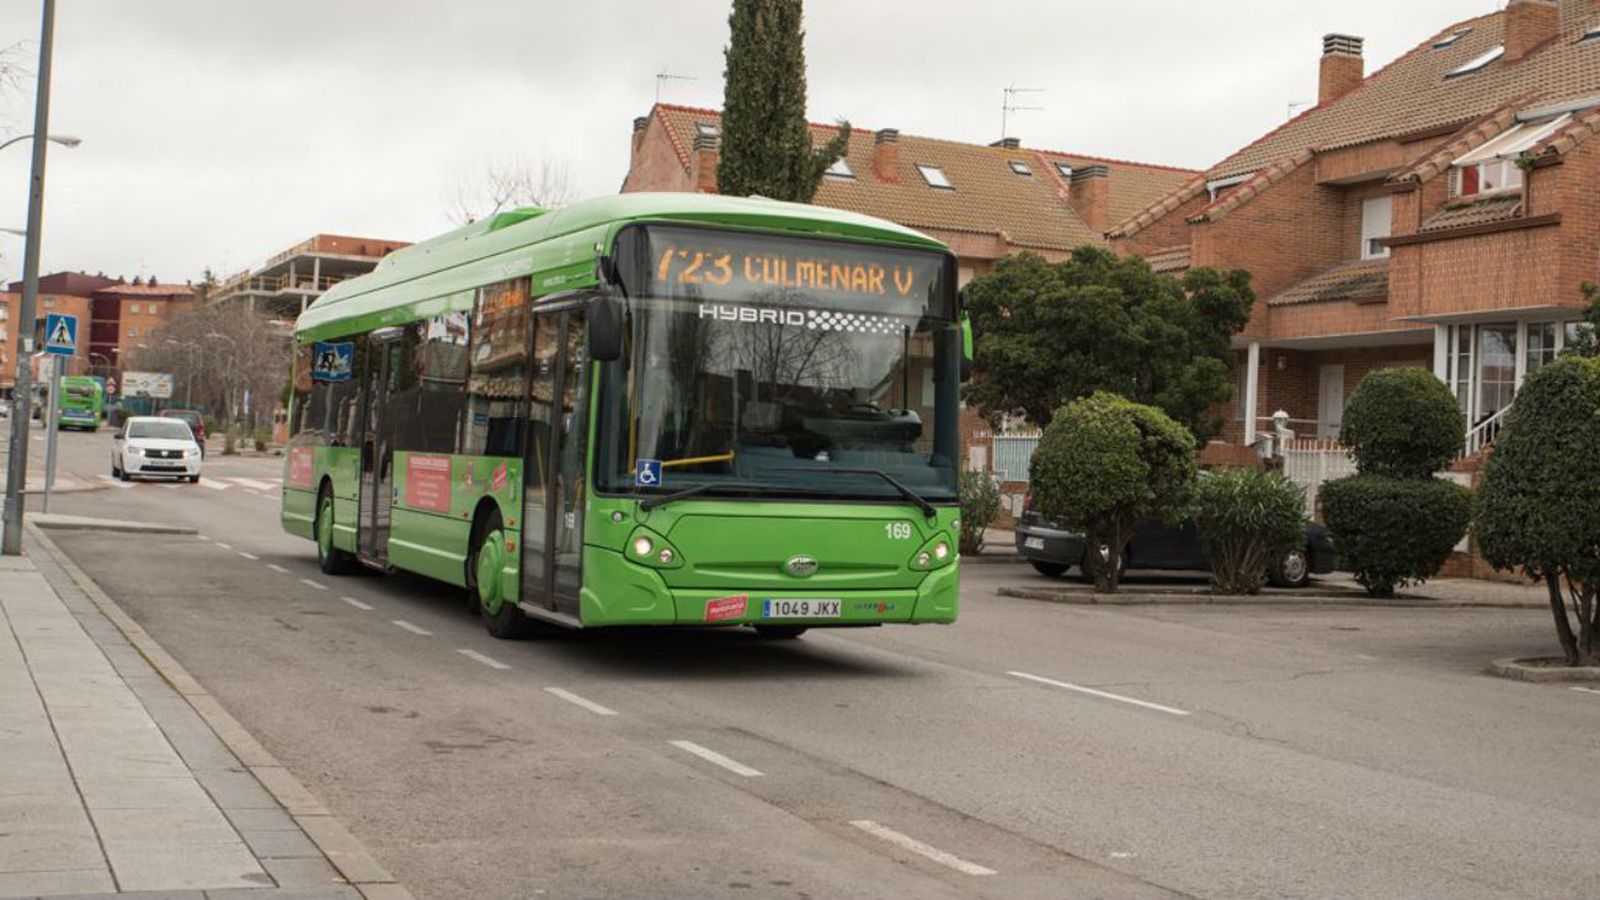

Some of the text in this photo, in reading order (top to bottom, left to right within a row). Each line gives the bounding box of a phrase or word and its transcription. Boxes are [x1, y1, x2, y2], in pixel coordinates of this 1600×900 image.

[893, 264, 914, 296] V
[699, 304, 804, 325] HYBRID
[884, 523, 911, 539] 169
[775, 601, 840, 616] 1049 JKX
